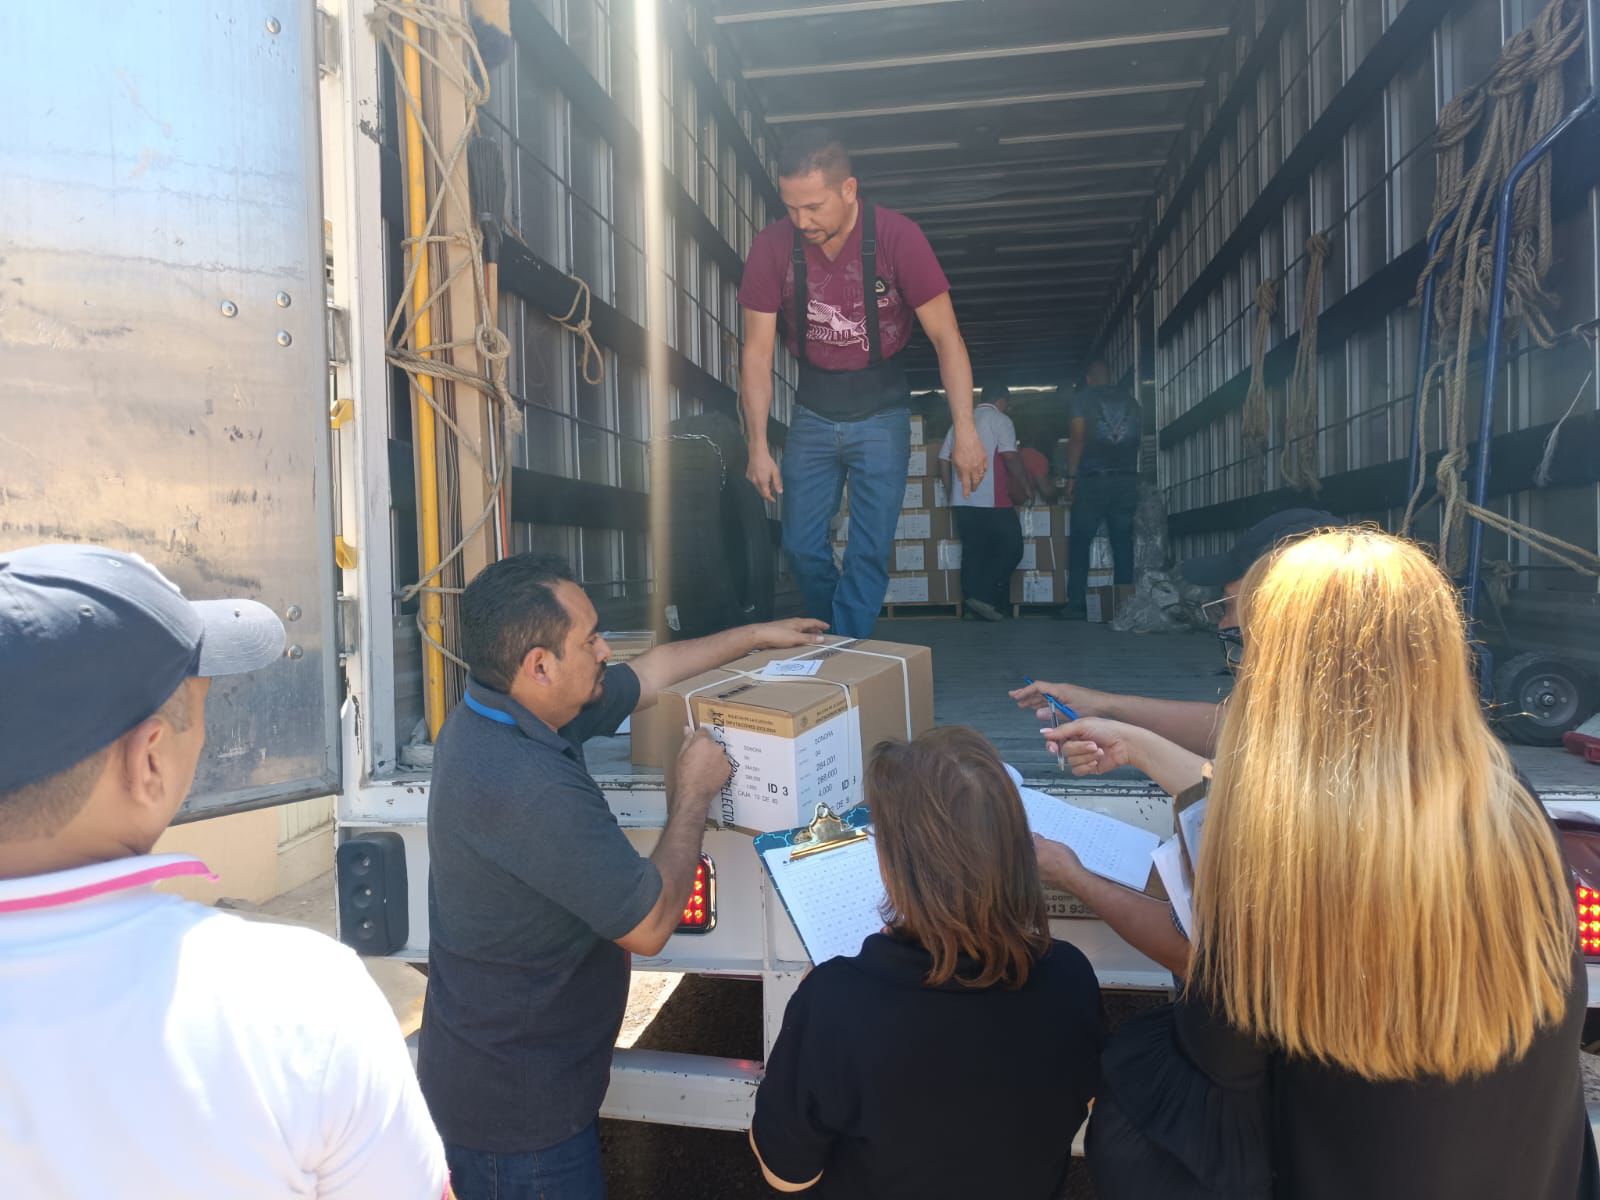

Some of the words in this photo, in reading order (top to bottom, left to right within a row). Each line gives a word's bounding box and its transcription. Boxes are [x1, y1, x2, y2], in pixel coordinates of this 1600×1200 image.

[814, 730, 834, 745] SONORA
[743, 745, 762, 753] SONORA
[767, 783, 778, 794] ID
[782, 786, 789, 796] 3
[841, 779, 850, 791] ID
